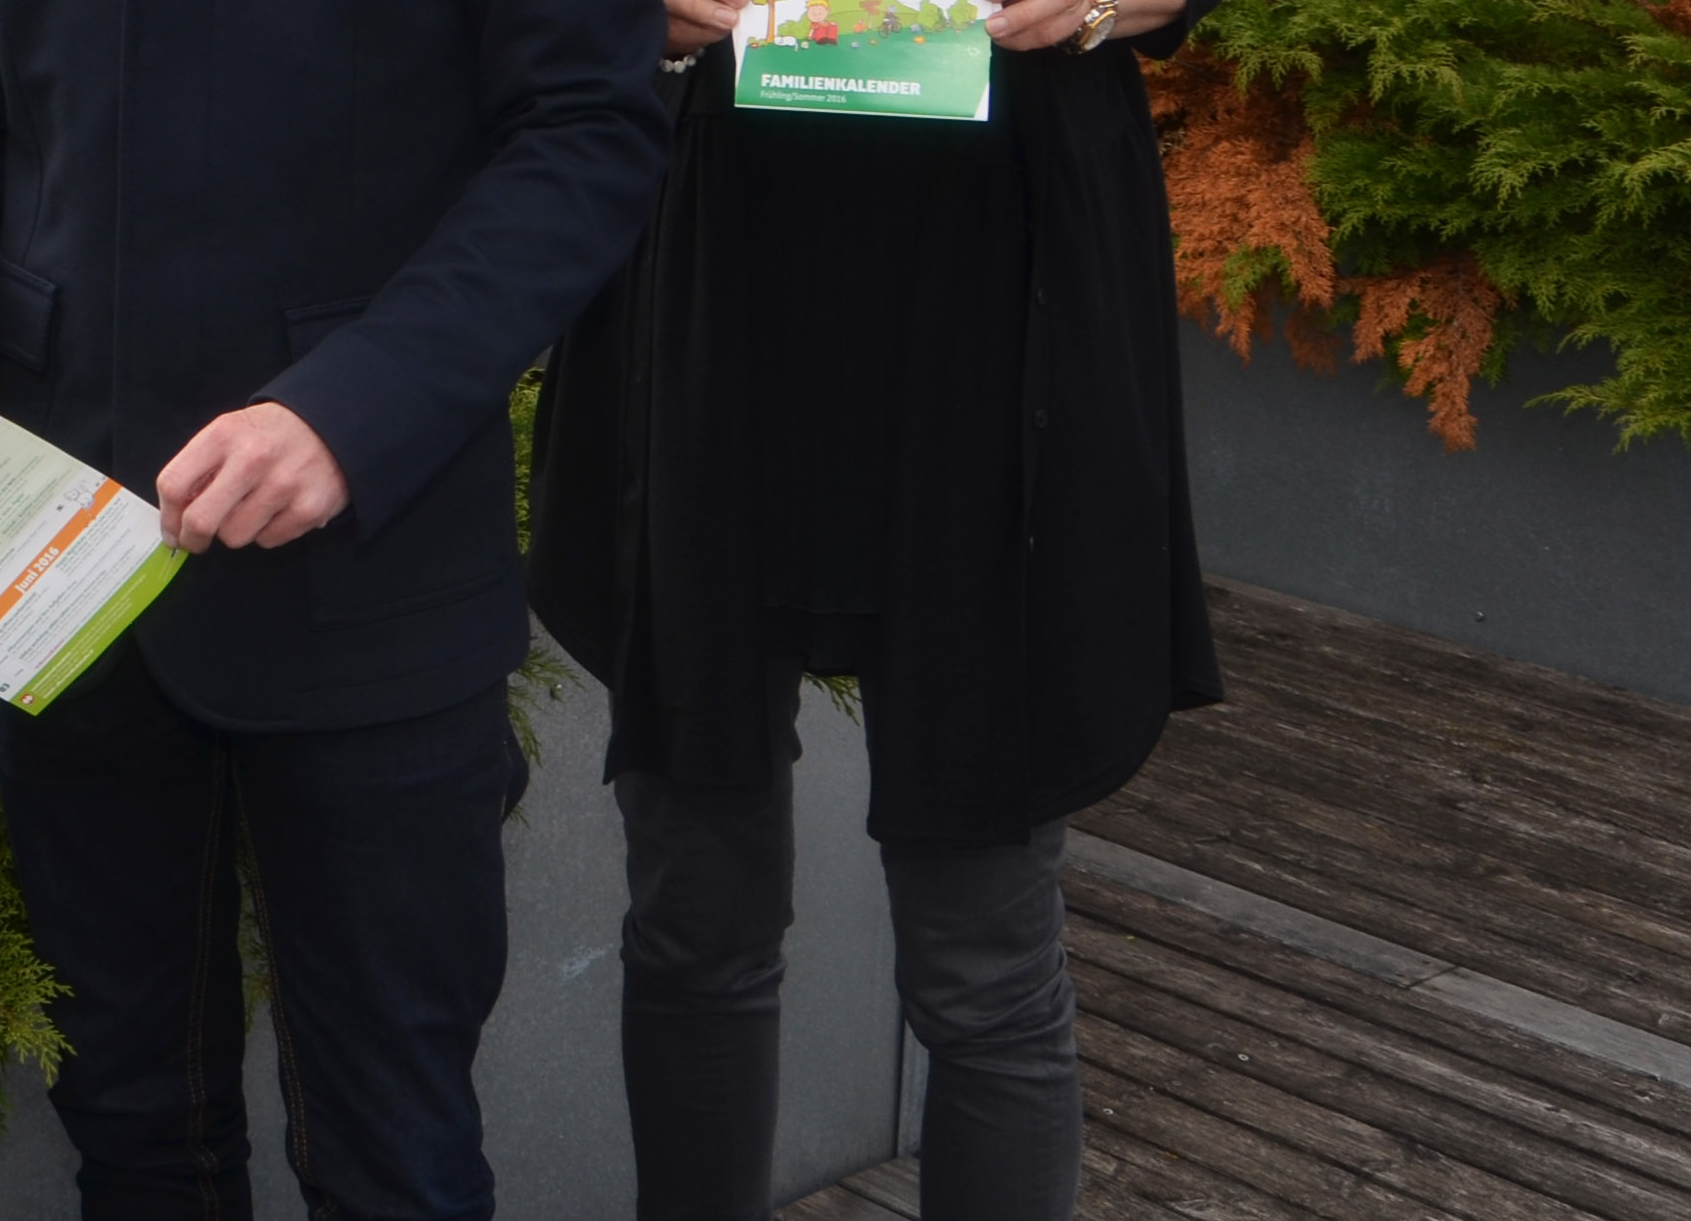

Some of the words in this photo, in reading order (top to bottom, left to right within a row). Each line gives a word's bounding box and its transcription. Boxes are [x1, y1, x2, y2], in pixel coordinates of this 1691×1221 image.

[761, 74, 921, 95] FAMILIENKALENDER
[826, 93, 847, 103] 2016
[14, 569, 39, 594] Juni
[33, 547, 59, 573] 2016
[0, 683, 10, 692] 03
